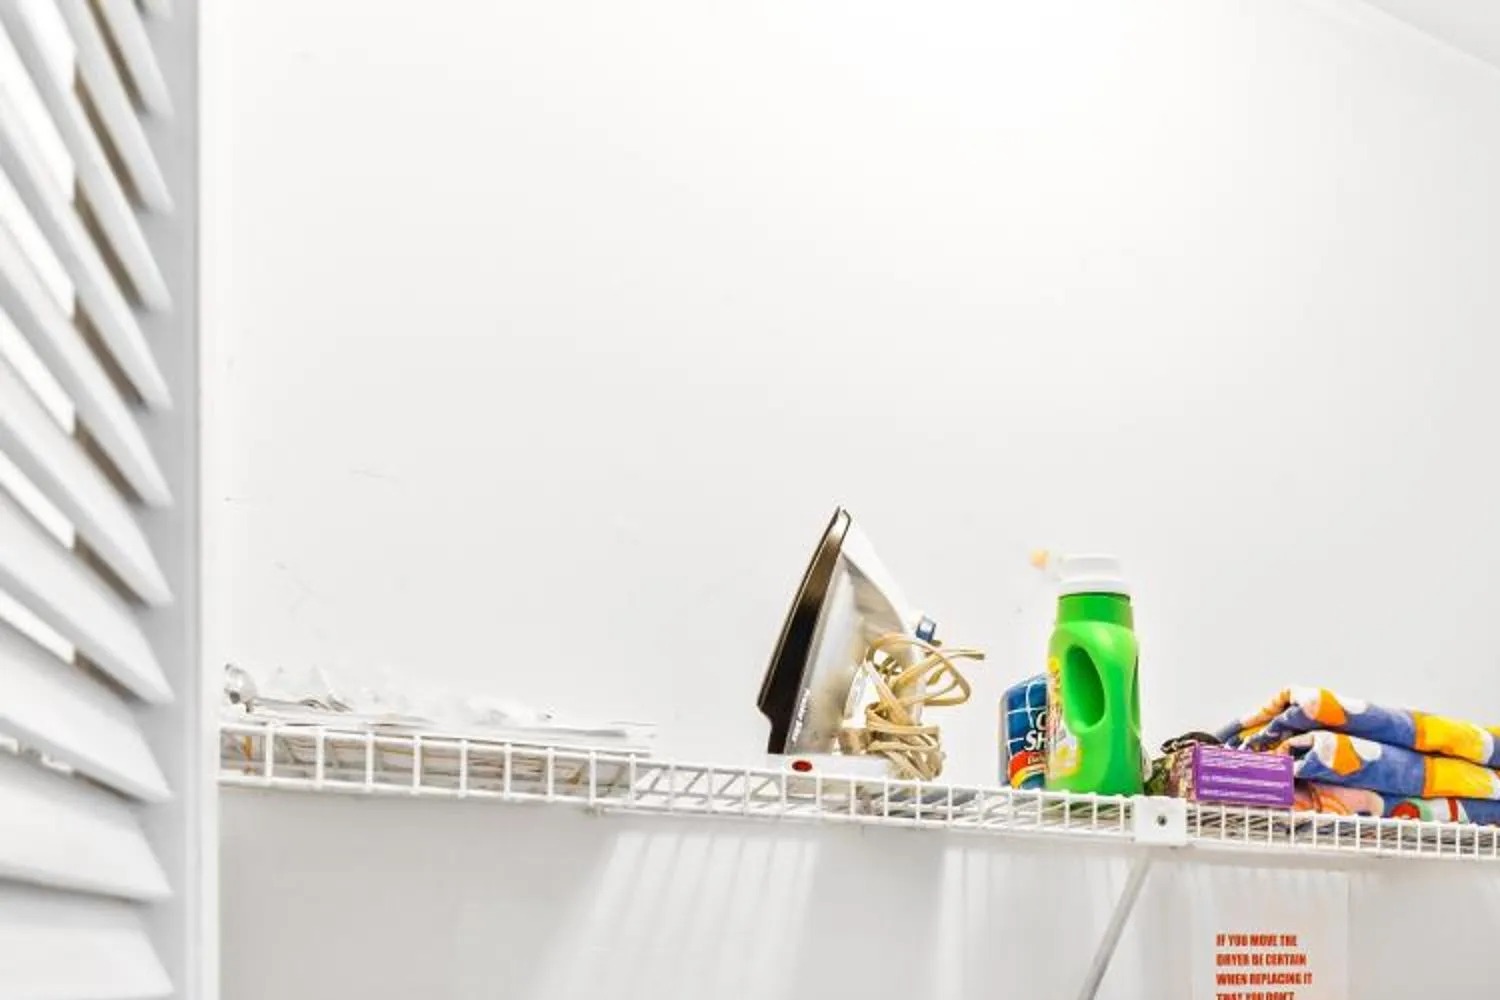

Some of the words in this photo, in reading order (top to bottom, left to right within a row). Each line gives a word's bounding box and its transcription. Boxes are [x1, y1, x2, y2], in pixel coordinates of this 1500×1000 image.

[1216, 934, 1225, 946] IF
[1228, 934, 1248, 946] YOU
[1250, 934, 1277, 946] MOVE
[1280, 935, 1296, 946] THE
[1216, 954, 1249, 966] DRYER
[1251, 954, 1264, 966] BE
[1265, 954, 1307, 966] CERTAIN
[1216, 973, 1248, 985] WHEN
[1249, 973, 1302, 985] REPLACING
[1304, 972, 1312, 984] IT
